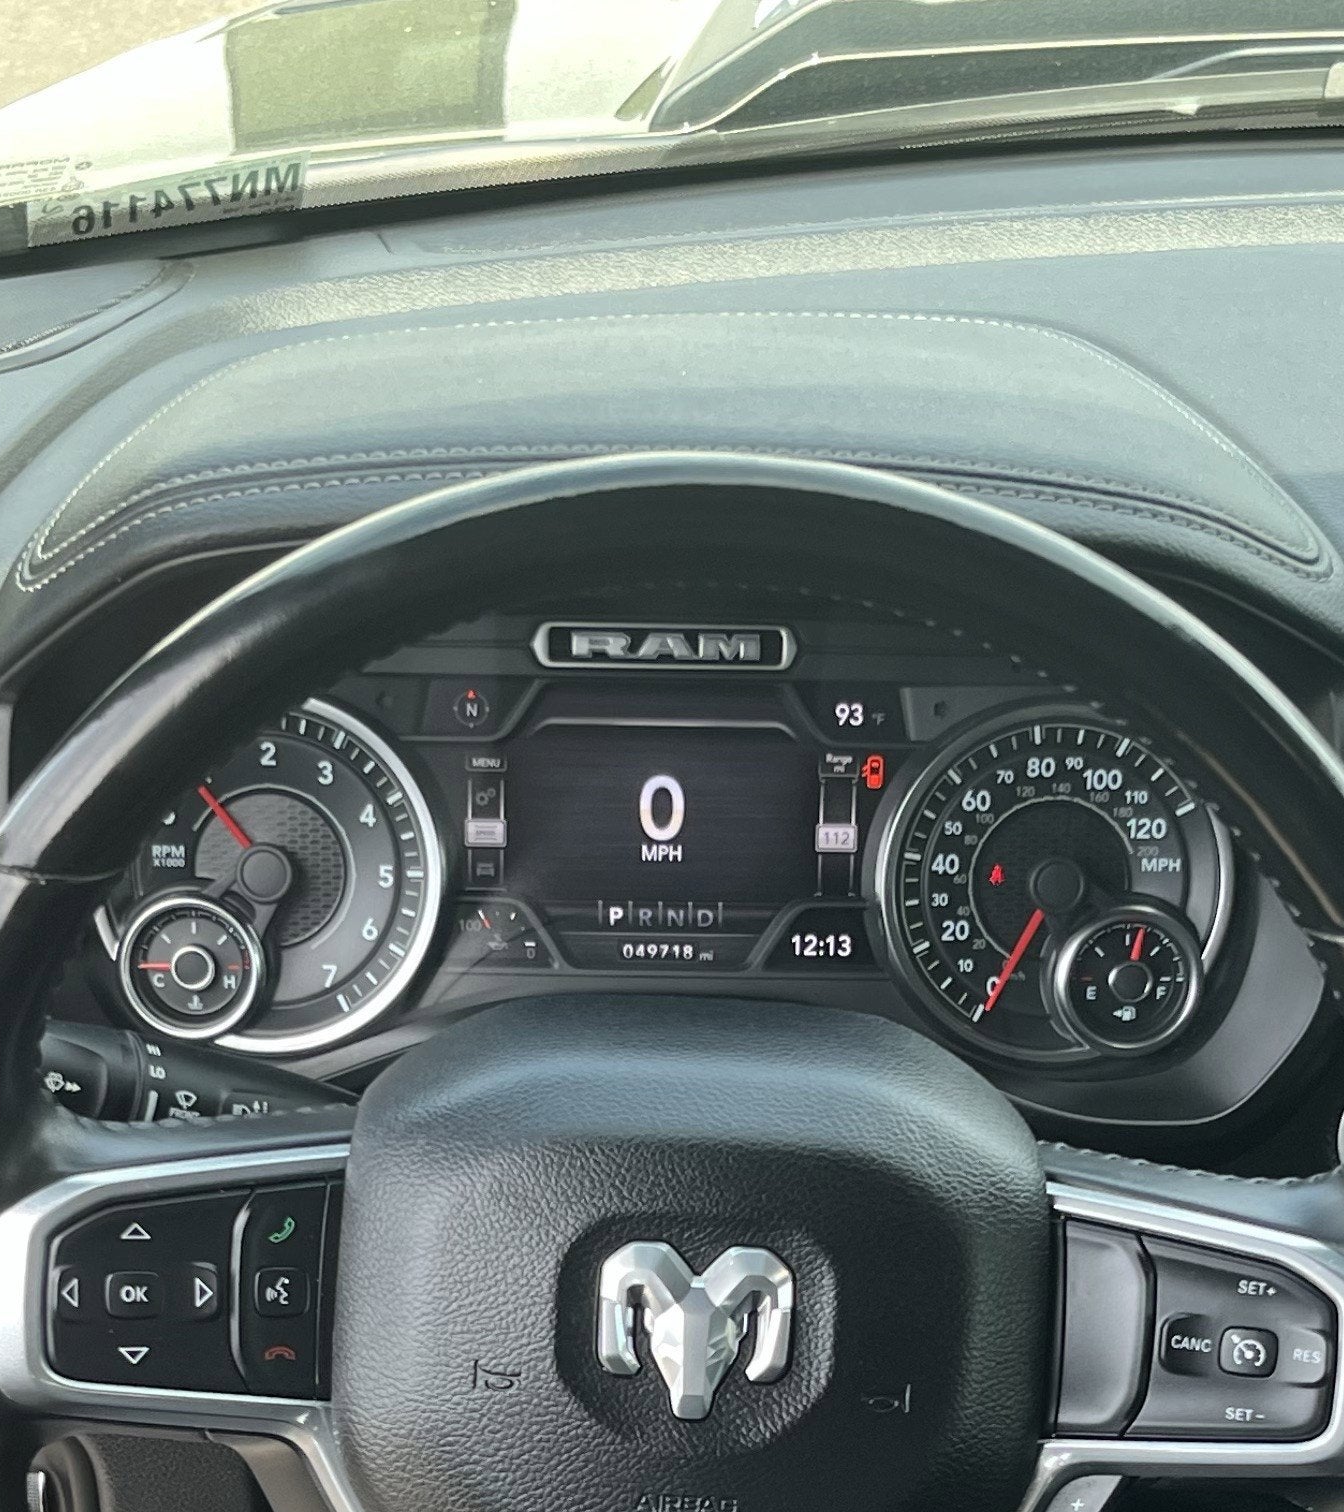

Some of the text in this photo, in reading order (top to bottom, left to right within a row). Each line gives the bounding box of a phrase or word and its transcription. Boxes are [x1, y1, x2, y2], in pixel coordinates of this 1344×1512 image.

[570, 631, 761, 661] RAM
[466, 703, 478, 717] N
[834, 702, 865, 727] 93
[259, 742, 277, 768] 2
[471, 757, 501, 768] MENU
[317, 760, 335, 785] 3
[996, 769, 1014, 785] 70
[1026, 756, 1084, 779] 80 90
[1082, 768, 1123, 791] 100
[961, 789, 991, 812] 60
[1124, 791, 1148, 805] 110
[359, 803, 378, 828] 4
[639, 774, 686, 842] 0
[944, 820, 963, 836] 50
[1126, 817, 1167, 840] 120
[822, 831, 850, 846] 112
[151, 844, 186, 860] RPM
[641, 845, 683, 863] MPH
[931, 853, 960, 875] 40
[1140, 857, 1182, 873] MPH
[377, 865, 395, 889] 5
[931, 893, 949, 907] 30
[609, 906, 714, 928] P R N D
[362, 917, 380, 942] 6
[941, 919, 970, 942] 20
[622, 943, 694, 960] 049718
[791, 934, 852, 957] 12:13
[957, 959, 974, 973] 10
[152, 973, 166, 989] C
[222, 975, 237, 990] H
[322, 964, 339, 989] 7
[1085, 985, 1097, 1001] E
[1156, 985, 1167, 1001] F
[120, 1285, 148, 1303] OK
[1170, 1333, 1212, 1354] CANC
[1292, 1347, 1322, 1365] RES
